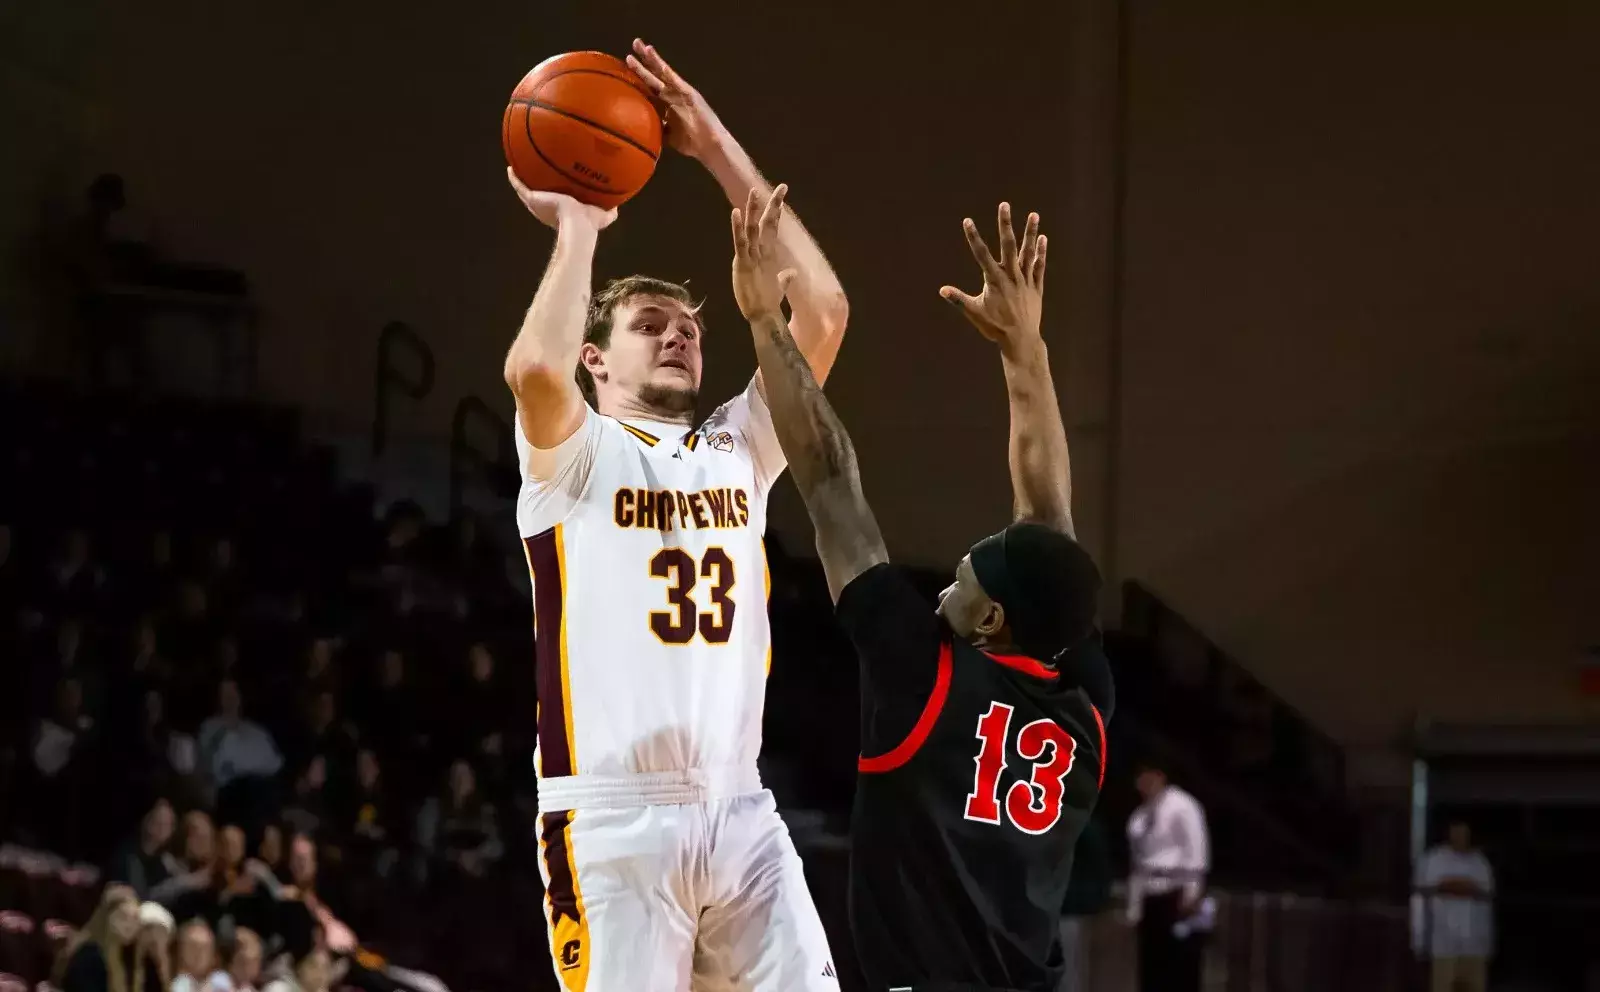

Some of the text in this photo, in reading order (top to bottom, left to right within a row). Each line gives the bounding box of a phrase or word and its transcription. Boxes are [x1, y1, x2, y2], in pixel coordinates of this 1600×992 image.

[649, 545, 737, 646] 33
[964, 701, 1077, 835] 13
[560, 939, 581, 966] C
